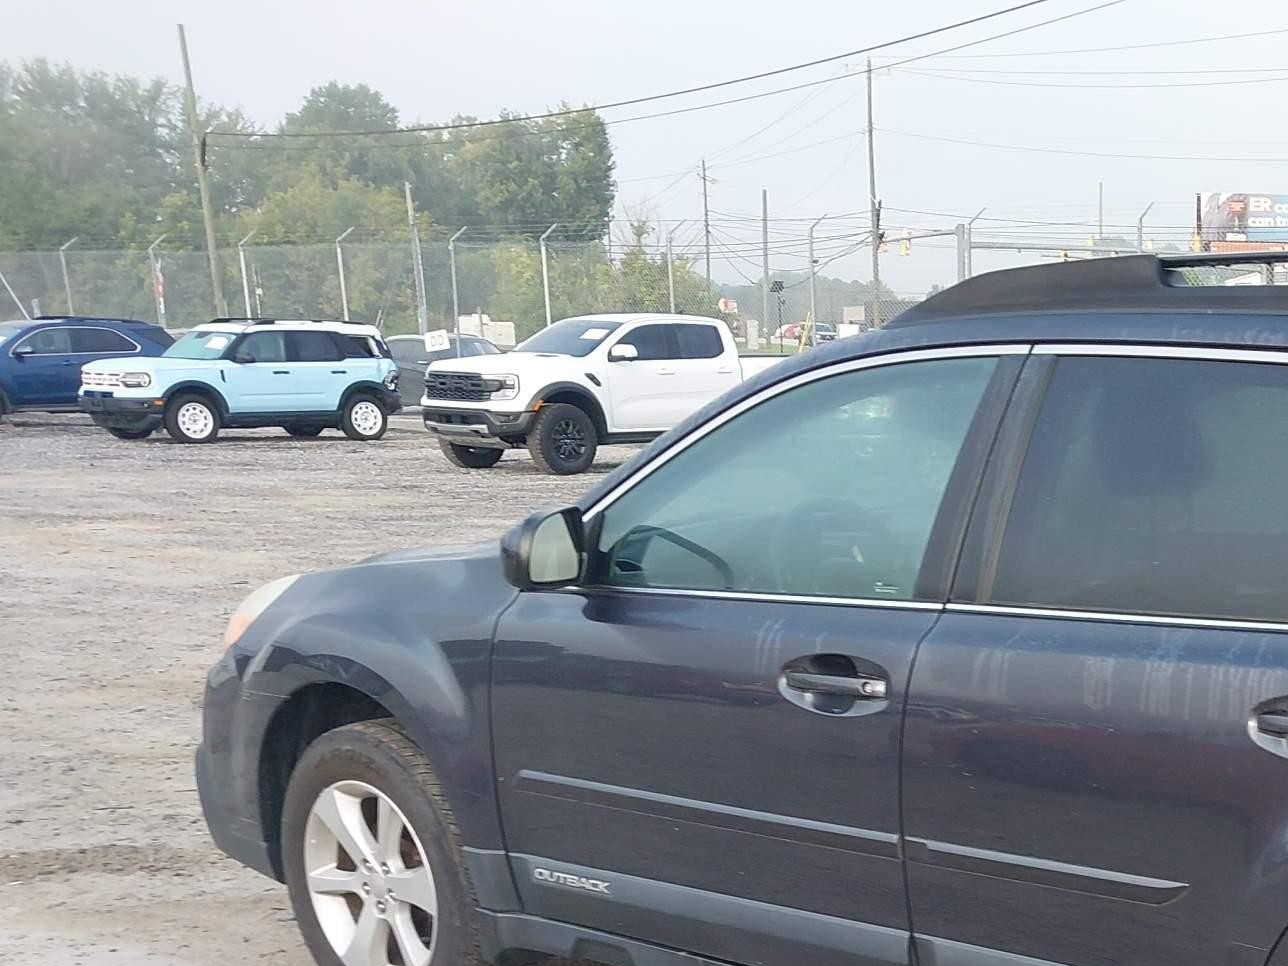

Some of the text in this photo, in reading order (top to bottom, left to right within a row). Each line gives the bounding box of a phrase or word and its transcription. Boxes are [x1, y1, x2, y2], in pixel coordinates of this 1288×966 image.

[1249, 197, 1272, 212] ER
[1248, 217, 1274, 227] can
[533, 868, 611, 894] OUTBACK
